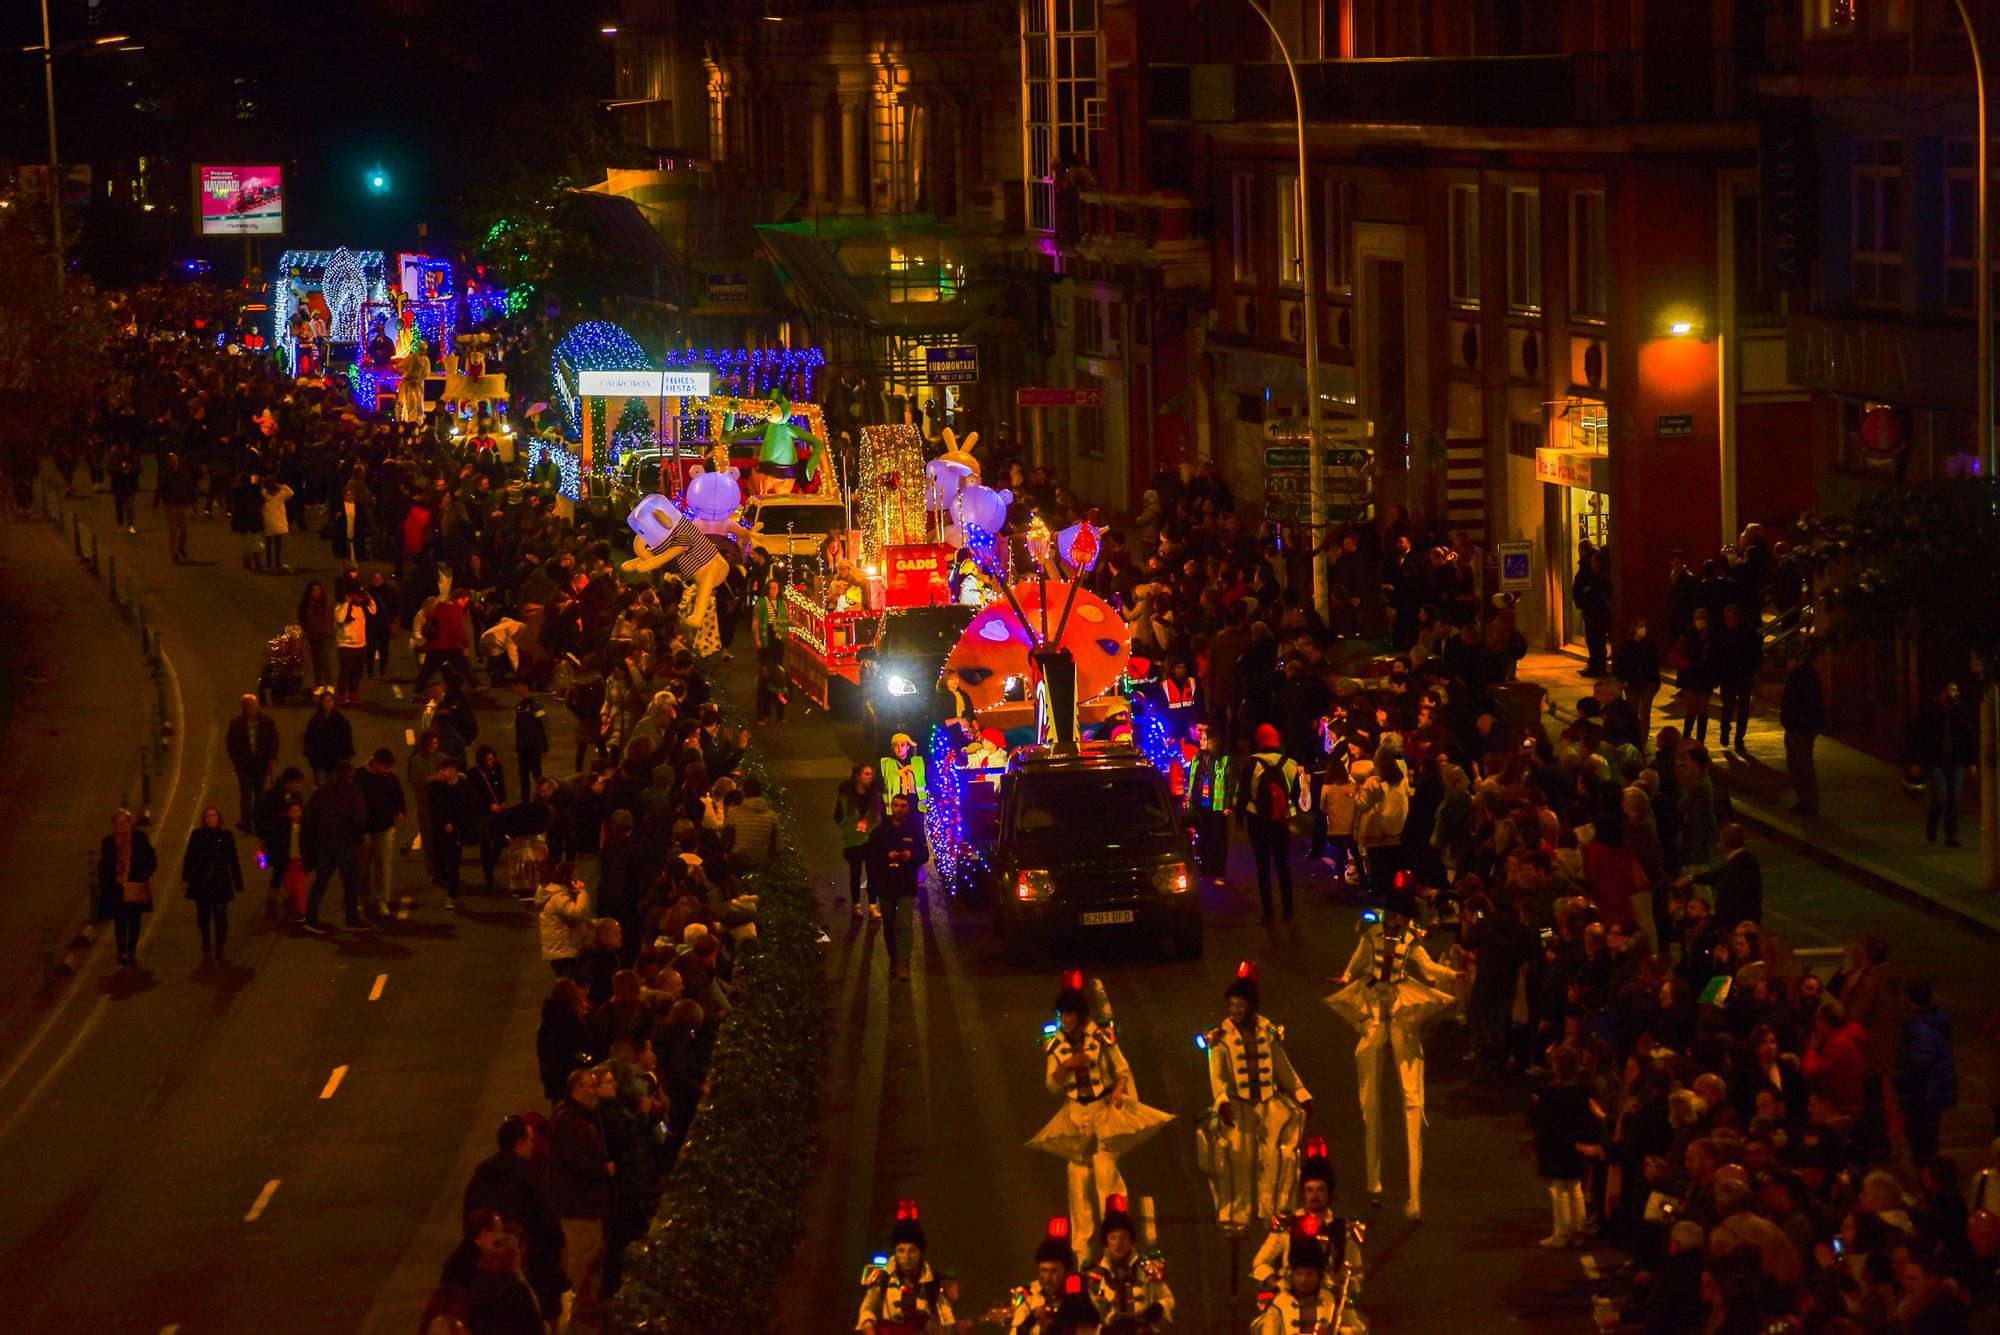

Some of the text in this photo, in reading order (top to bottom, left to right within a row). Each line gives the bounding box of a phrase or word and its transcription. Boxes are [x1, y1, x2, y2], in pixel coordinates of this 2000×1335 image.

[664, 376, 695, 385] FELICES
[665, 384, 697, 393] FIESTAS
[895, 558, 938, 571] GADIS
[1085, 913, 1110, 924] 6291
